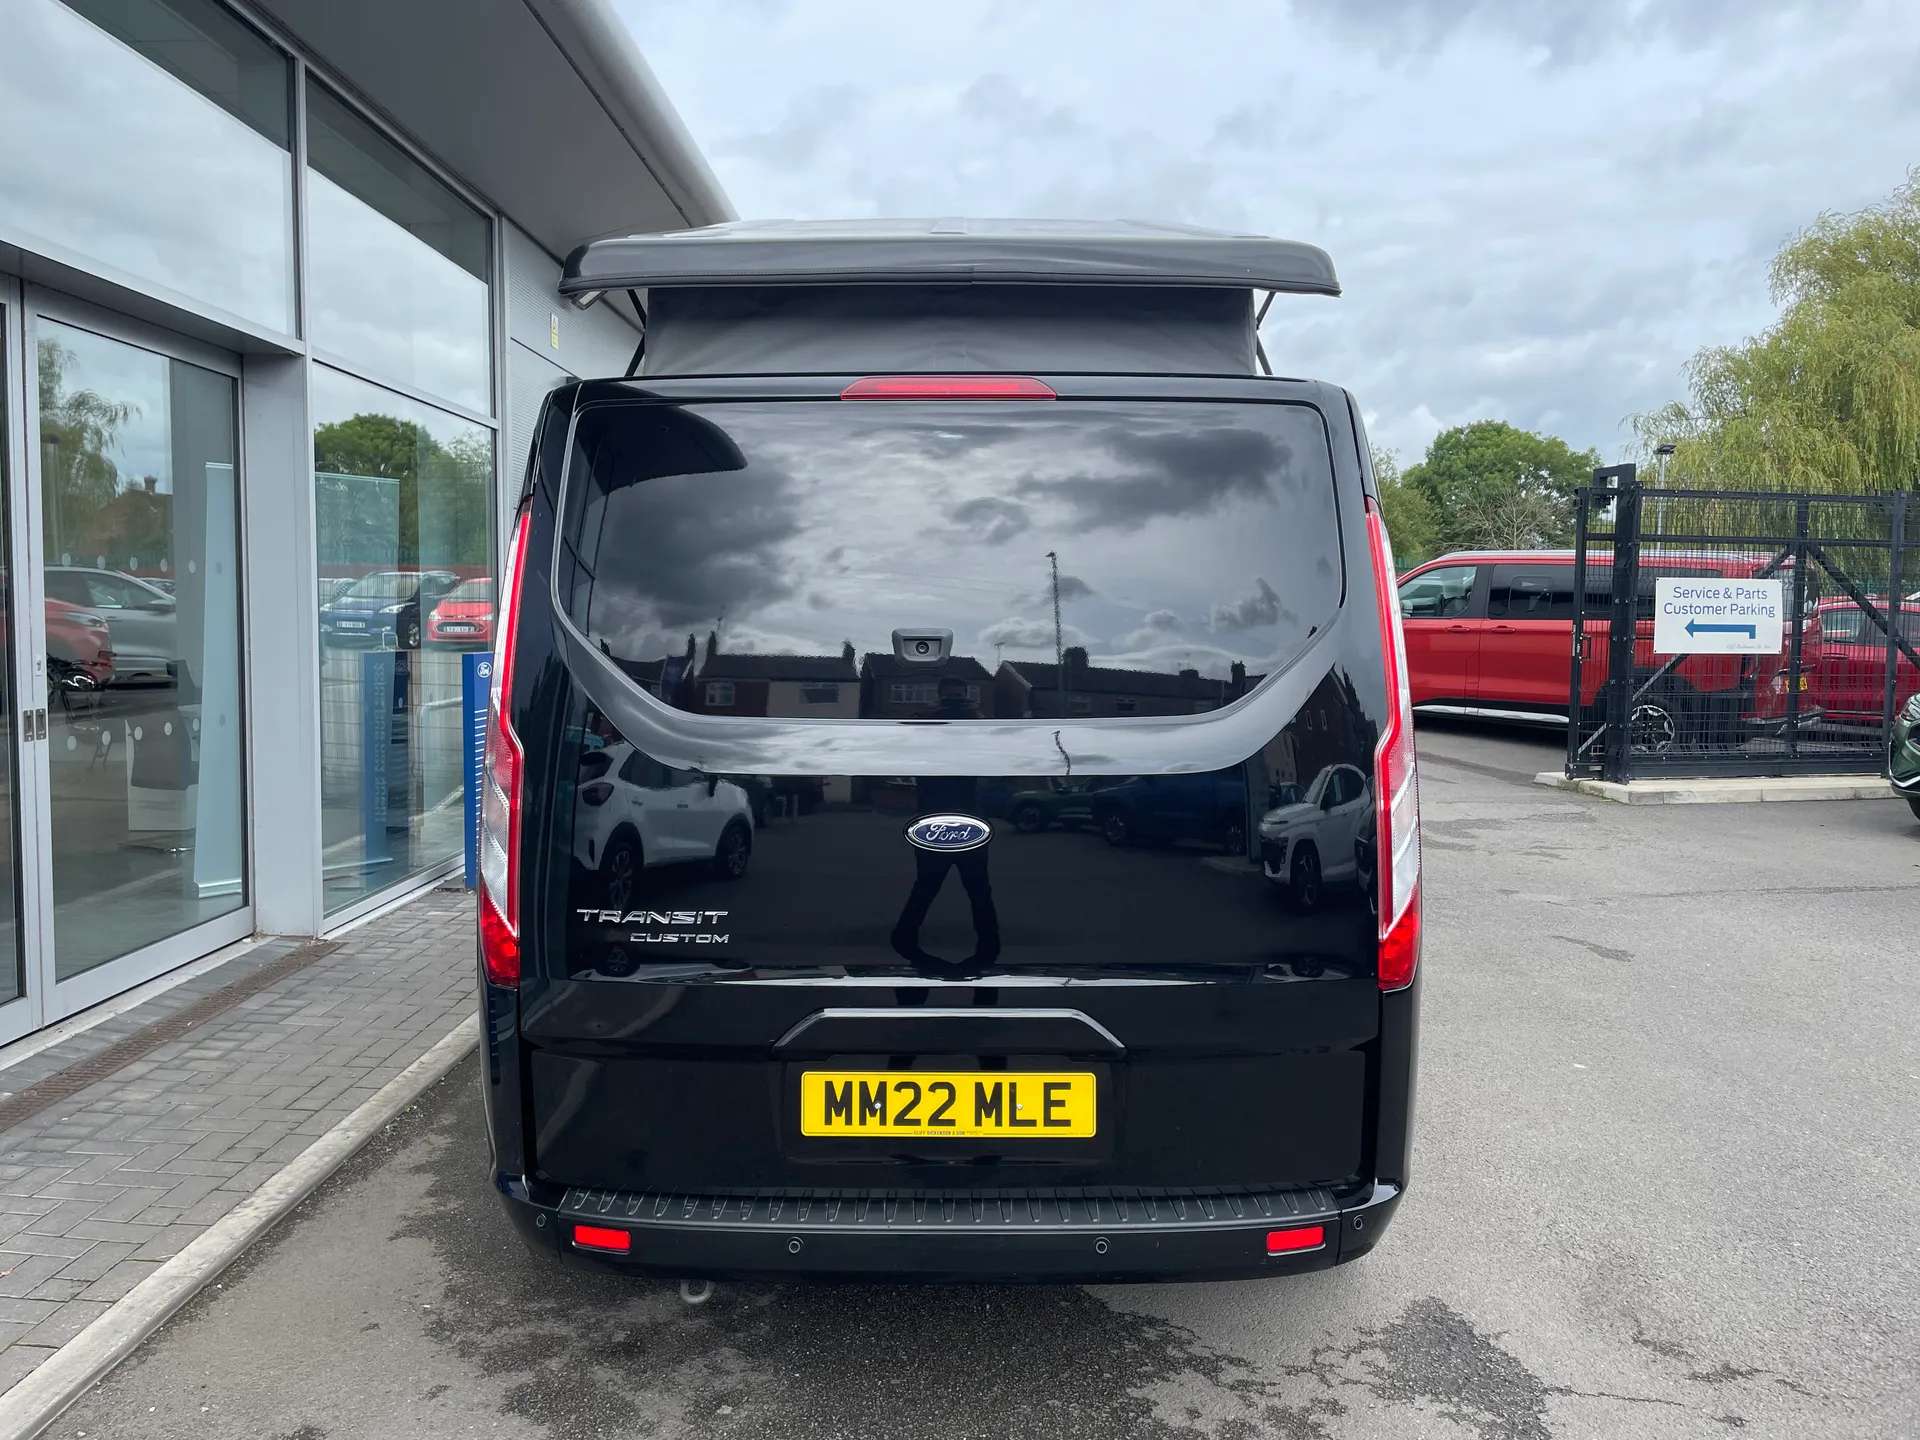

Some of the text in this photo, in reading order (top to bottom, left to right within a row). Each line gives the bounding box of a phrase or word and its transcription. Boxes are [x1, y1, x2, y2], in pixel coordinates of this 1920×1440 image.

[1673, 586, 1768, 600] Service & Parts
[1663, 602, 1776, 618] Customer Parking
[925, 822, 972, 841] Ford
[576, 908, 729, 925] TRANSIT
[629, 932, 730, 944] CUSTOM
[824, 1080, 1072, 1128] MM22 MLE
